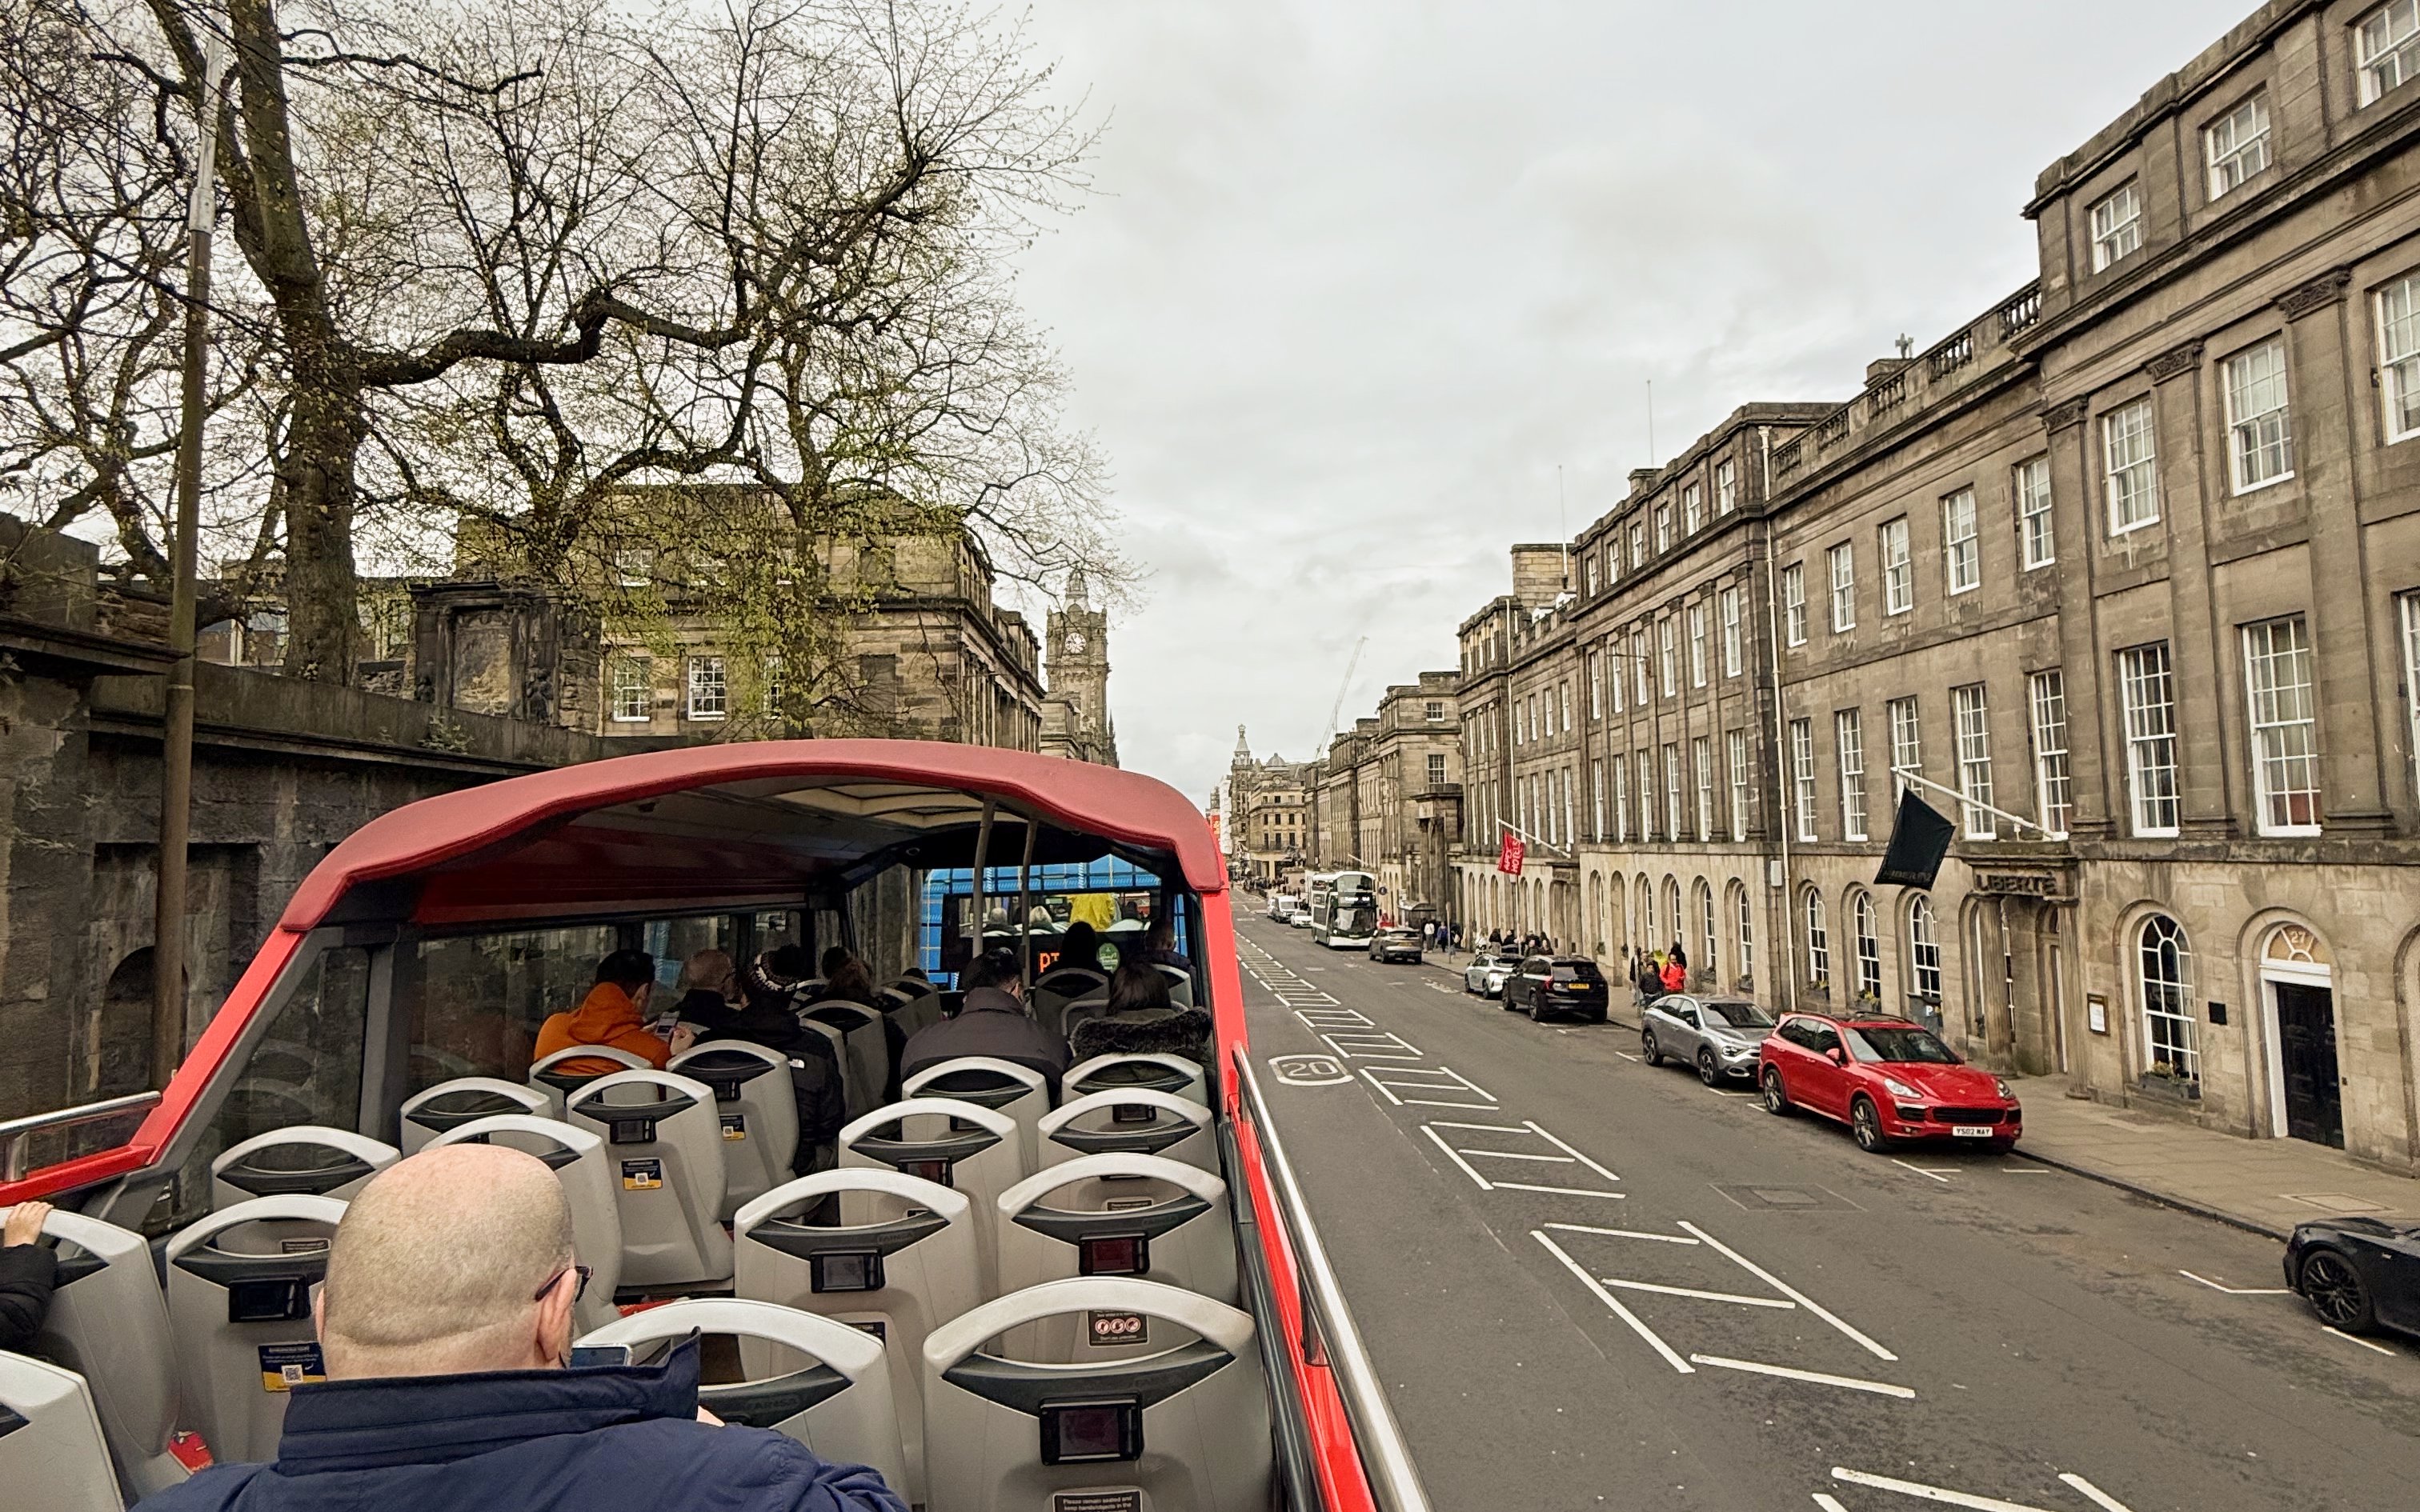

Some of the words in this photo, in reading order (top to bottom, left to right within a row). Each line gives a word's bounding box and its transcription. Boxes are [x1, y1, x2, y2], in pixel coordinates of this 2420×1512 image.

[1976, 870, 2057, 895] LIBERTÉ
[2290, 930, 2306, 943] 27
[1281, 1060, 1339, 1077] 20
